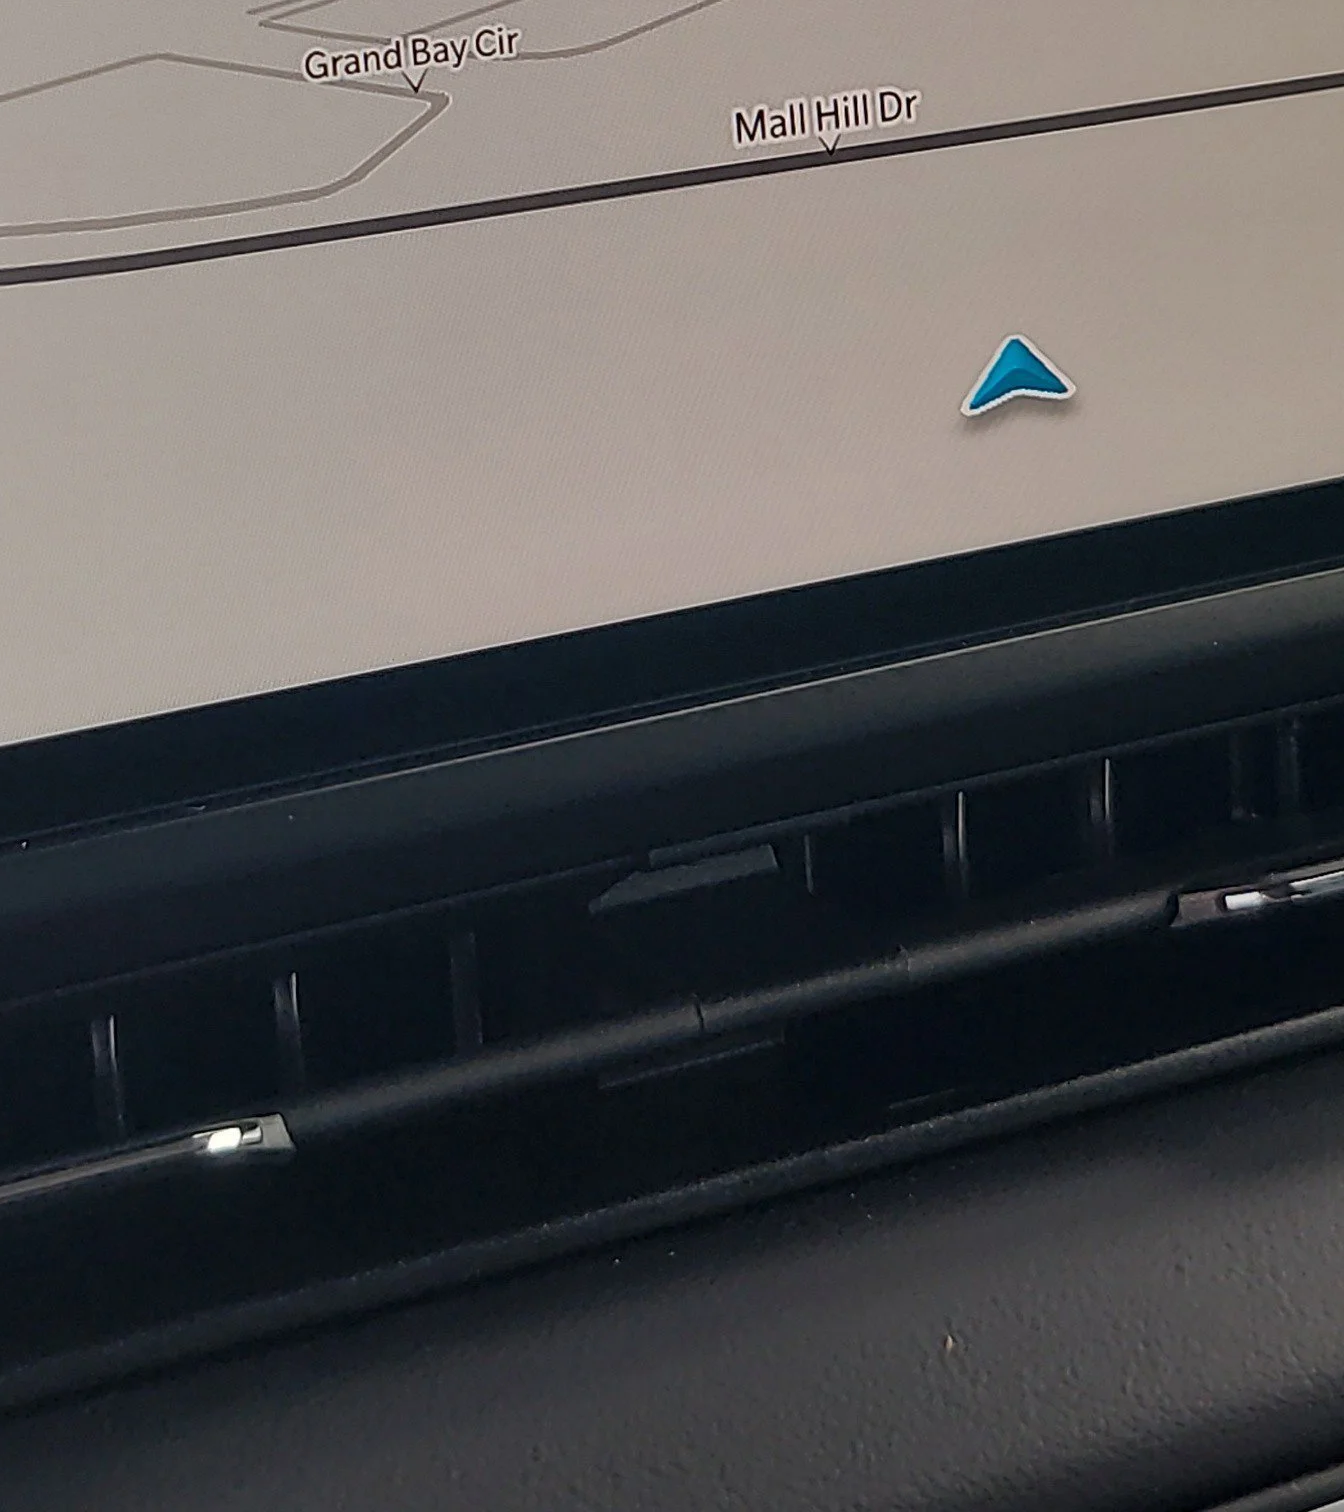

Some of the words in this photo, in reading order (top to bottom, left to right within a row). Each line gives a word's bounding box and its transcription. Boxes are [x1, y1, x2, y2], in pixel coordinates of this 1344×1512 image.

[305, 39, 402, 80] Grand
[411, 37, 468, 68] Bay
[475, 26, 520, 58] Cir
[735, 102, 806, 144] Mall
[815, 93, 869, 132] Hill
[879, 91, 918, 123] Dr
